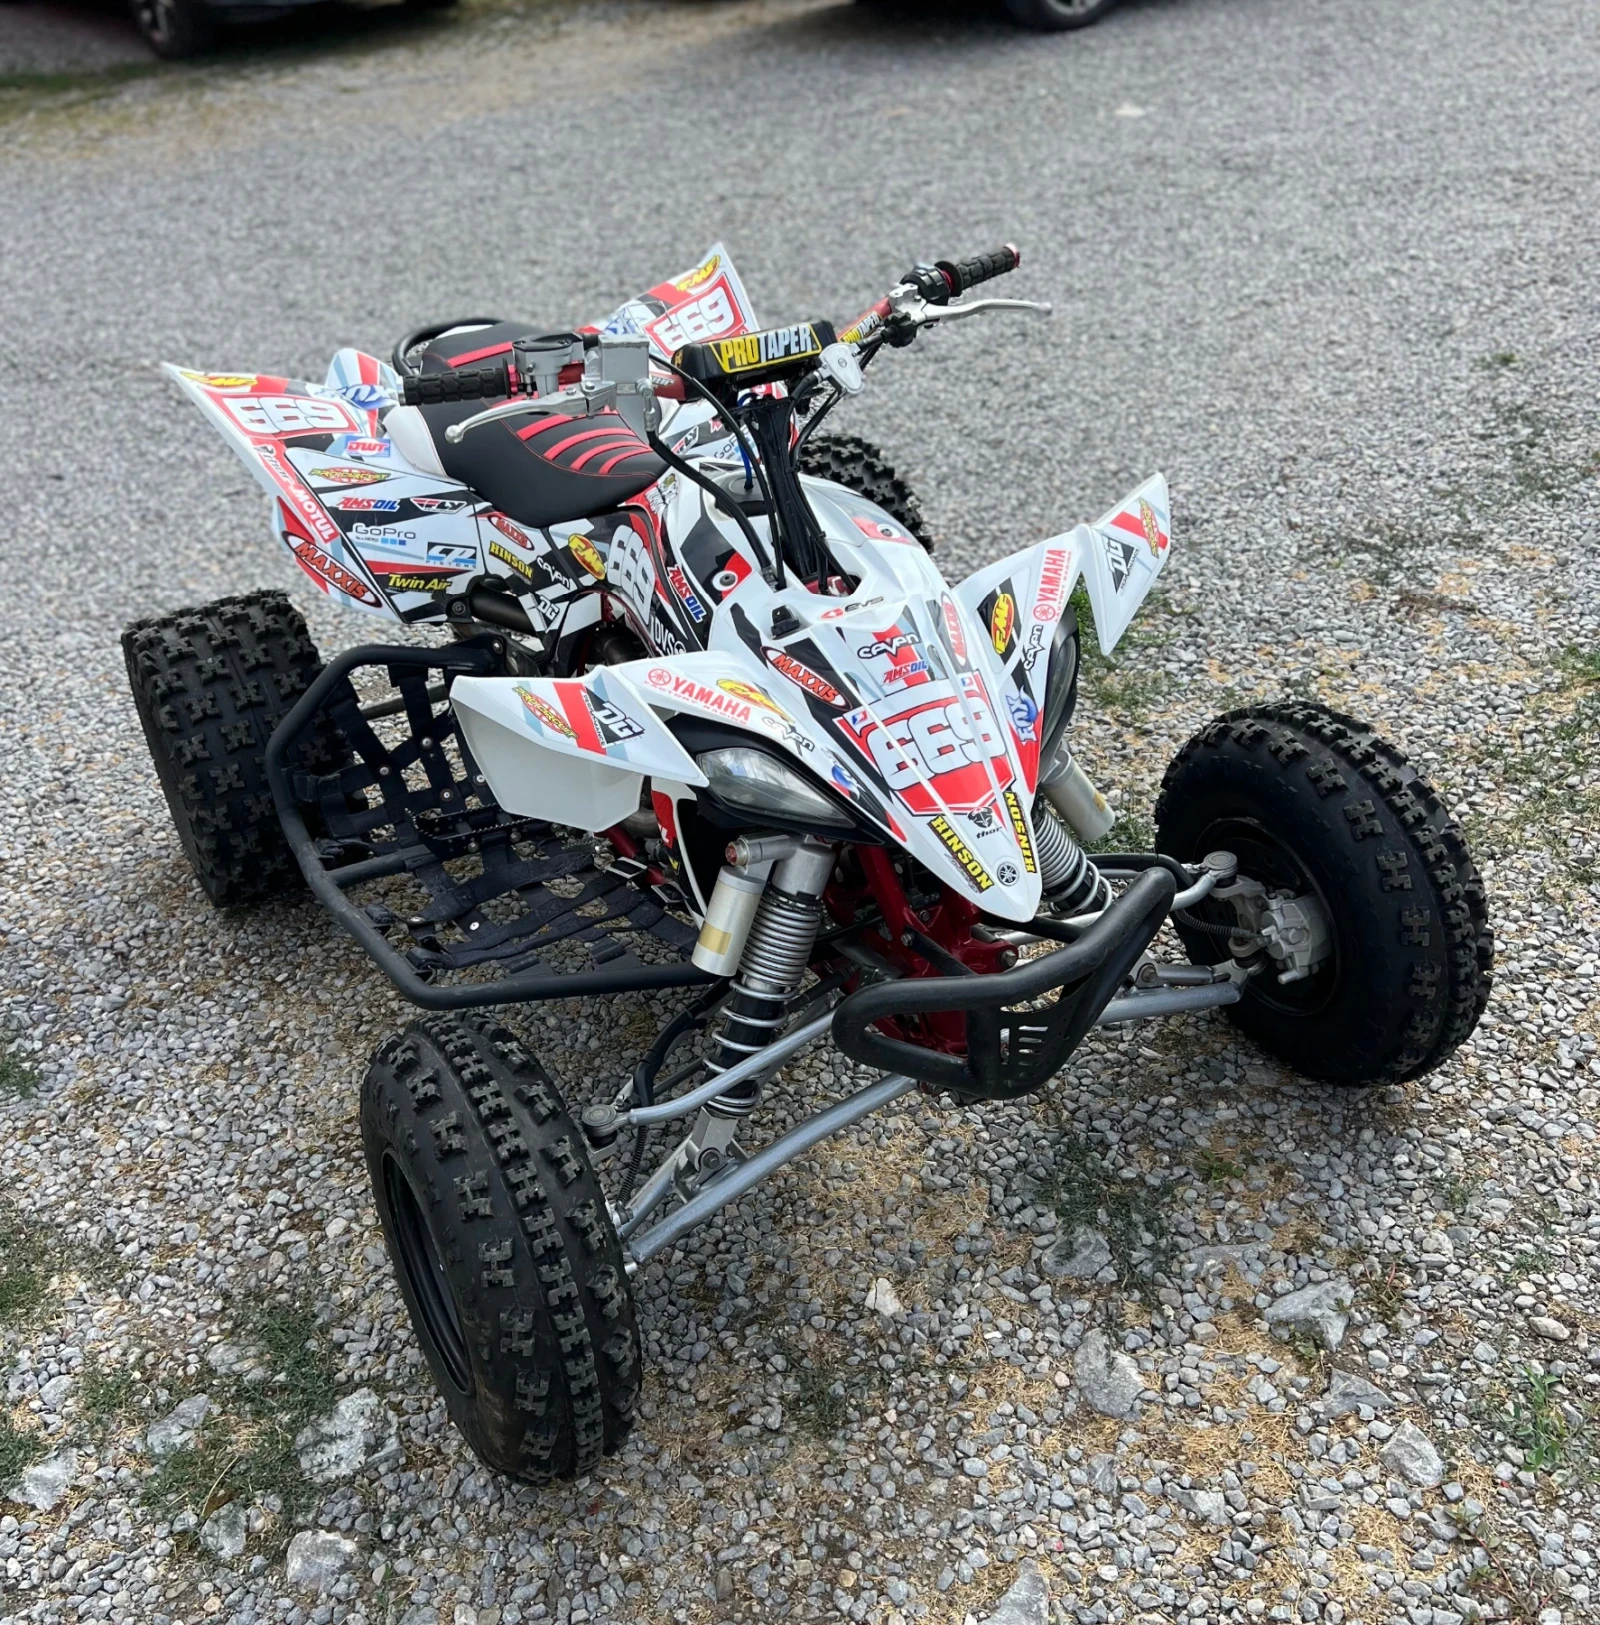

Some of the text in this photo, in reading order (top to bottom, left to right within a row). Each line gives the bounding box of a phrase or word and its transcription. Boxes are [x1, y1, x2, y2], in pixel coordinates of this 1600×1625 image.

[653, 286, 734, 351] 669
[720, 324, 812, 370] PROTAPER
[222, 397, 350, 434] 669
[347, 441, 389, 452] DWT
[290, 484, 335, 540] MOTUL
[338, 497, 399, 510] AMSOIL
[411, 498, 464, 512] FLY
[355, 525, 416, 539] GoPro
[296, 540, 368, 600] MAXXIS
[388, 574, 425, 589] Twin
[425, 578, 451, 590] Air
[489, 541, 532, 579] HINSON
[1037, 549, 1066, 602] YAMAHA
[538, 594, 560, 620] DG
[668, 565, 706, 621] AMSOIL
[992, 594, 1013, 654] FMF
[771, 653, 839, 703] MAXXIS
[883, 661, 928, 684] AMSOIL
[594, 700, 645, 739] DG
[673, 676, 751, 721] YAMAHA
[867, 695, 1007, 791] 669
[930, 815, 994, 890] HINSON
[976, 827, 1003, 839] thor
[1004, 791, 1035, 873] HINSON
